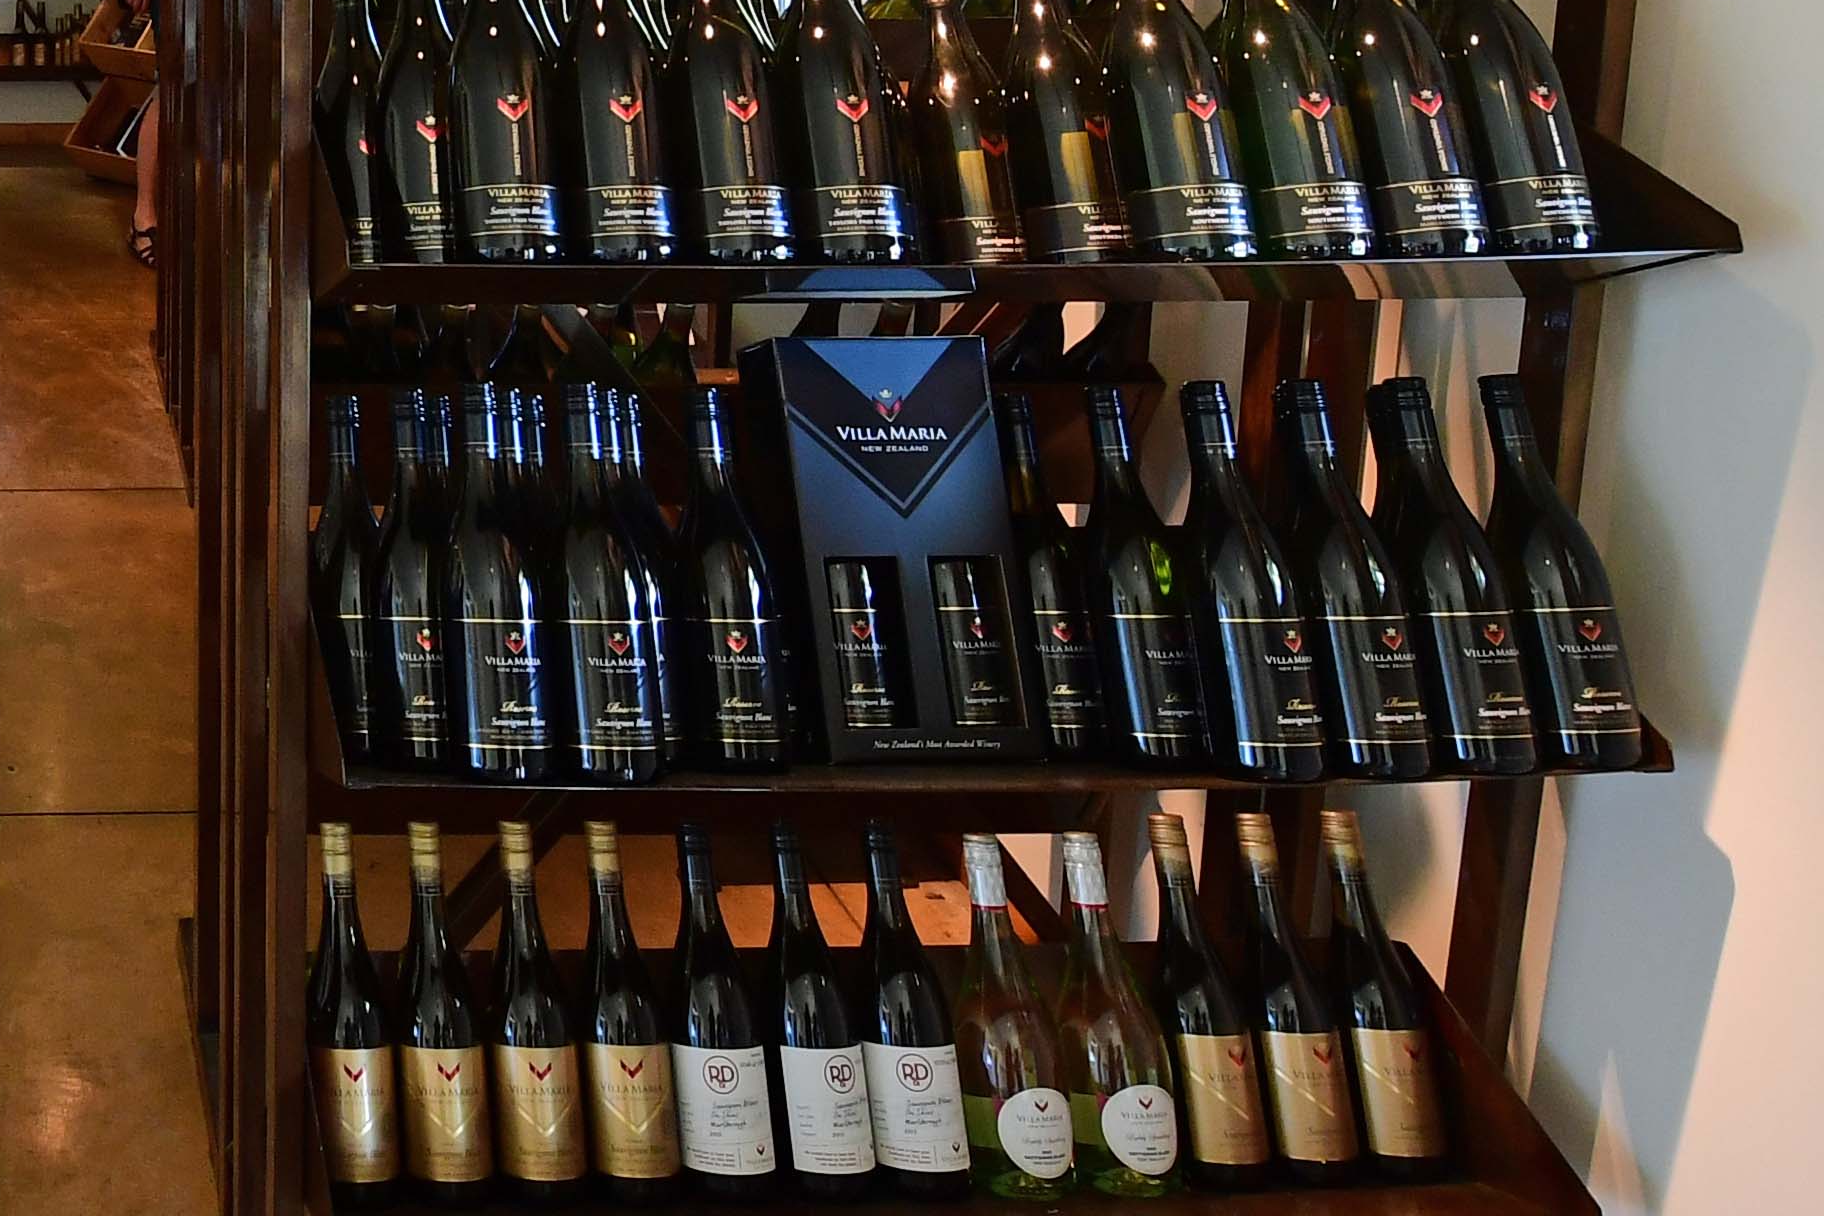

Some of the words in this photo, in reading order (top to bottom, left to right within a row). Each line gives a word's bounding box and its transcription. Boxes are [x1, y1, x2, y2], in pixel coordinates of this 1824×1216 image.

[488, 189, 520, 198] VILLA
[601, 190, 631, 198] VILLA
[720, 190, 750, 199] VILLA
[831, 190, 861, 198] VILLA
[1181, 189, 1213, 198] VILLA
[1295, 188, 1328, 197] VILLA
[1409, 185, 1443, 195] VILLA
[836, 425, 888, 440] VILLA
[890, 426, 947, 440] MARIA
[953, 641, 979, 649] VILLA
[1558, 644, 1590, 653] VILLA
[399, 653, 424, 661] VILLA
[1146, 650, 1175, 659] VILLA
[1464, 648, 1495, 657] VILLA
[485, 656, 513, 665] VILLA
[588, 657, 616, 666] VILLA
[707, 654, 735, 663] VILLA
[736, 655, 766, 664] MARIA
[1264, 655, 1293, 664] VILLA
[1362, 653, 1392, 662] VILLA
[873, 740, 889, 748] New
[926, 740, 942, 748] Most
[944, 740, 975, 748] Awarded
[977, 740, 1001, 750] Winery
